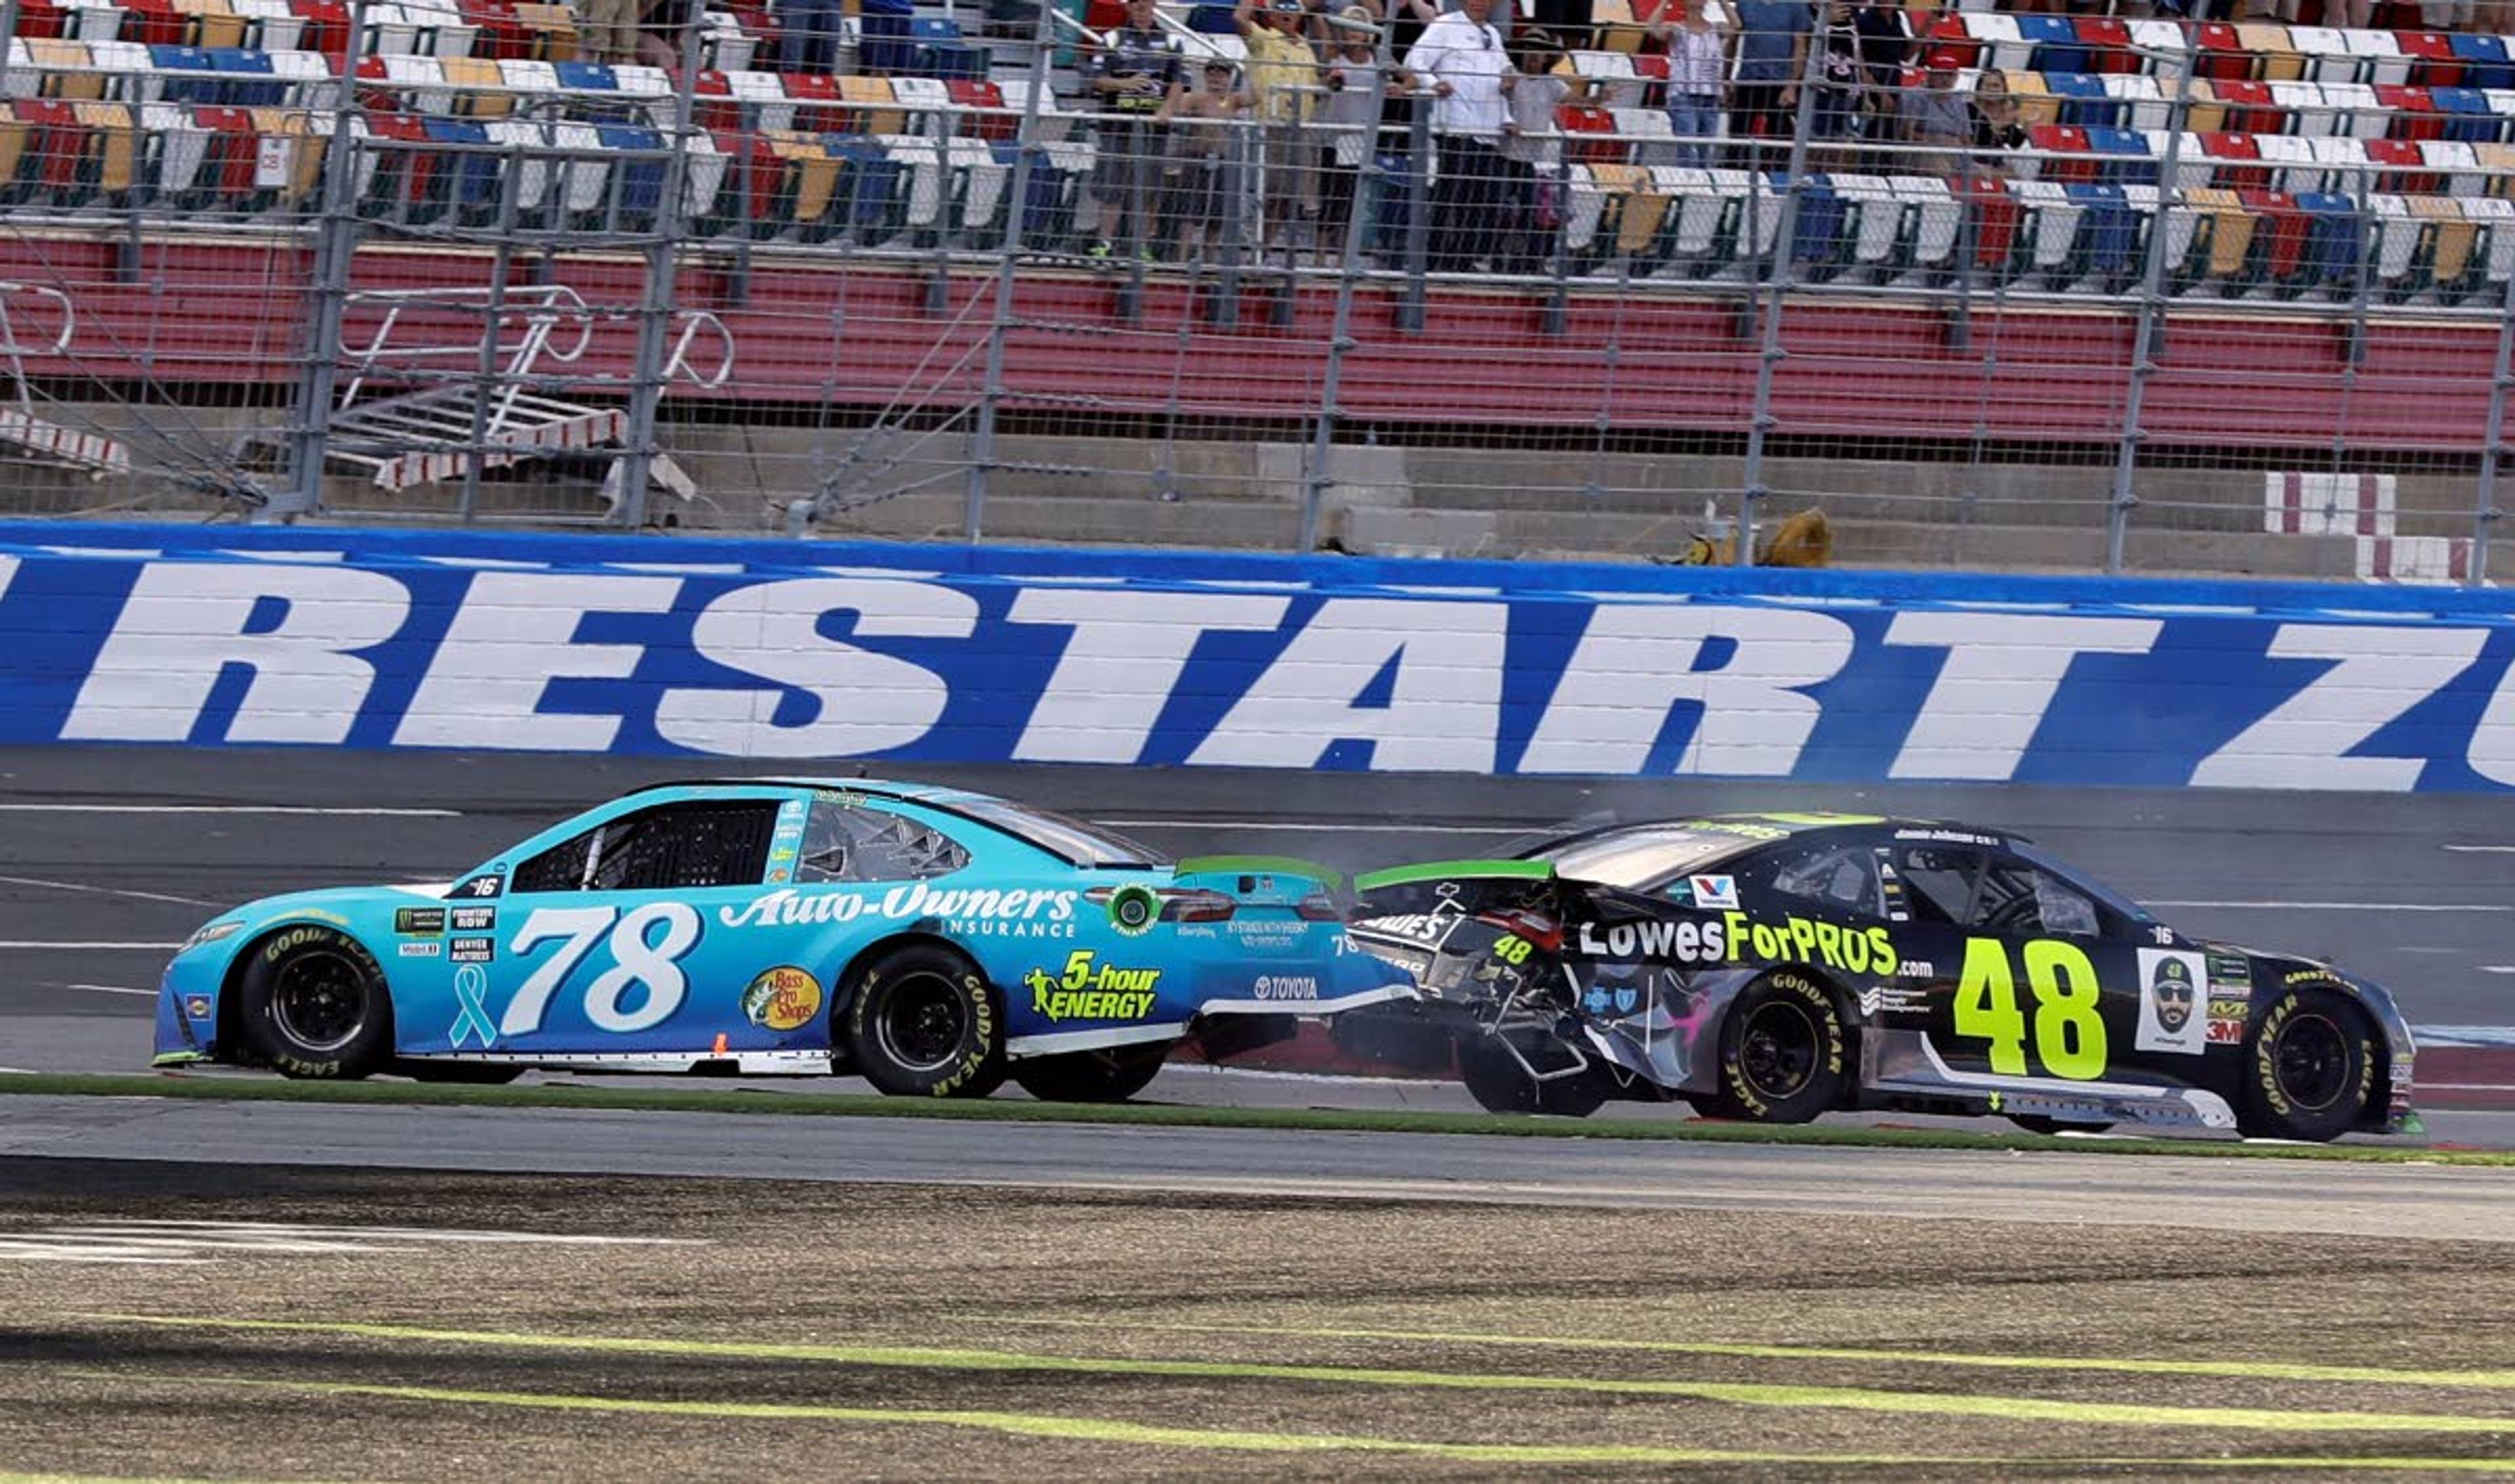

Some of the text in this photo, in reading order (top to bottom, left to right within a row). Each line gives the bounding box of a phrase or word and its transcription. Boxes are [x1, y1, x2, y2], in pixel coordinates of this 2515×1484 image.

[59, 562, 2515, 791] RESTART Z
[719, 884, 1079, 927] Auto-Owners
[457, 918, 487, 927] ROW
[941, 920, 1075, 938] INSURANCE
[1331, 935, 1360, 957] 78
[2155, 926, 2174, 945] 16
[1493, 935, 1533, 965] 48
[500, 901, 699, 1035] 78
[775, 970, 804, 988] Bass
[1062, 950, 1161, 991] 5-hour
[776, 986, 797, 1003] Pro
[1271, 976, 1317, 999] TOYOTA
[775, 1003, 812, 1022] Shops
[1050, 992, 1155, 1018] ENERGY
[1952, 937, 2108, 1081] 48
[1772, 973, 1843, 1075] GOODYEAR
[2206, 1020, 2241, 1041] 3M
